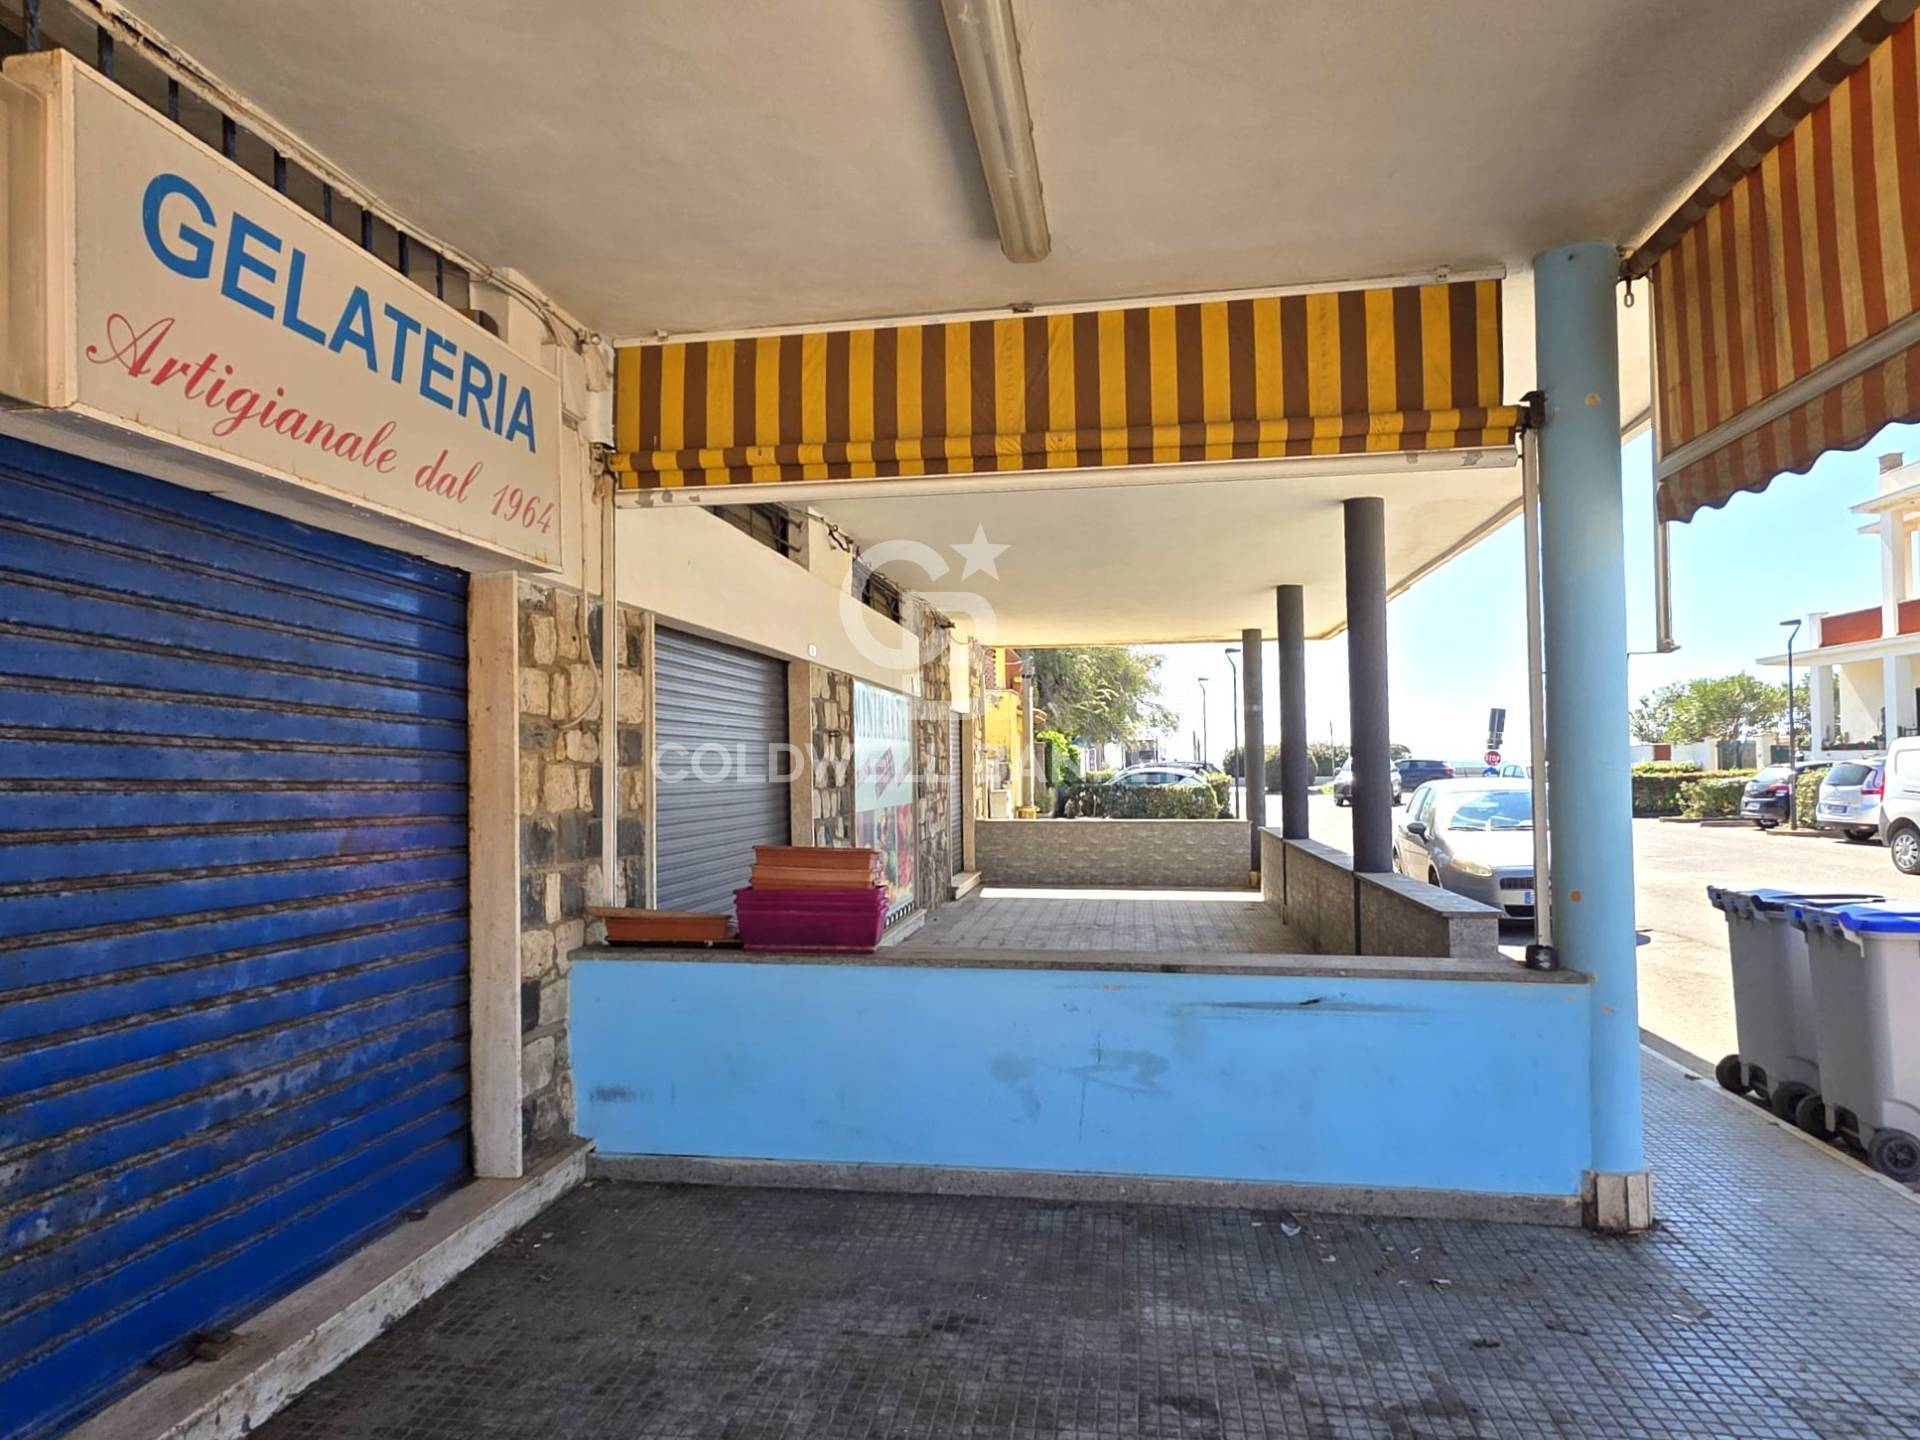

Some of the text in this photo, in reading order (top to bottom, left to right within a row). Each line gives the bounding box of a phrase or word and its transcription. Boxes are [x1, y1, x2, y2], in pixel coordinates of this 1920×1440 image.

[86, 313, 554, 534] Artigianale dal 1964
[142, 173, 537, 454] GELATERIA
